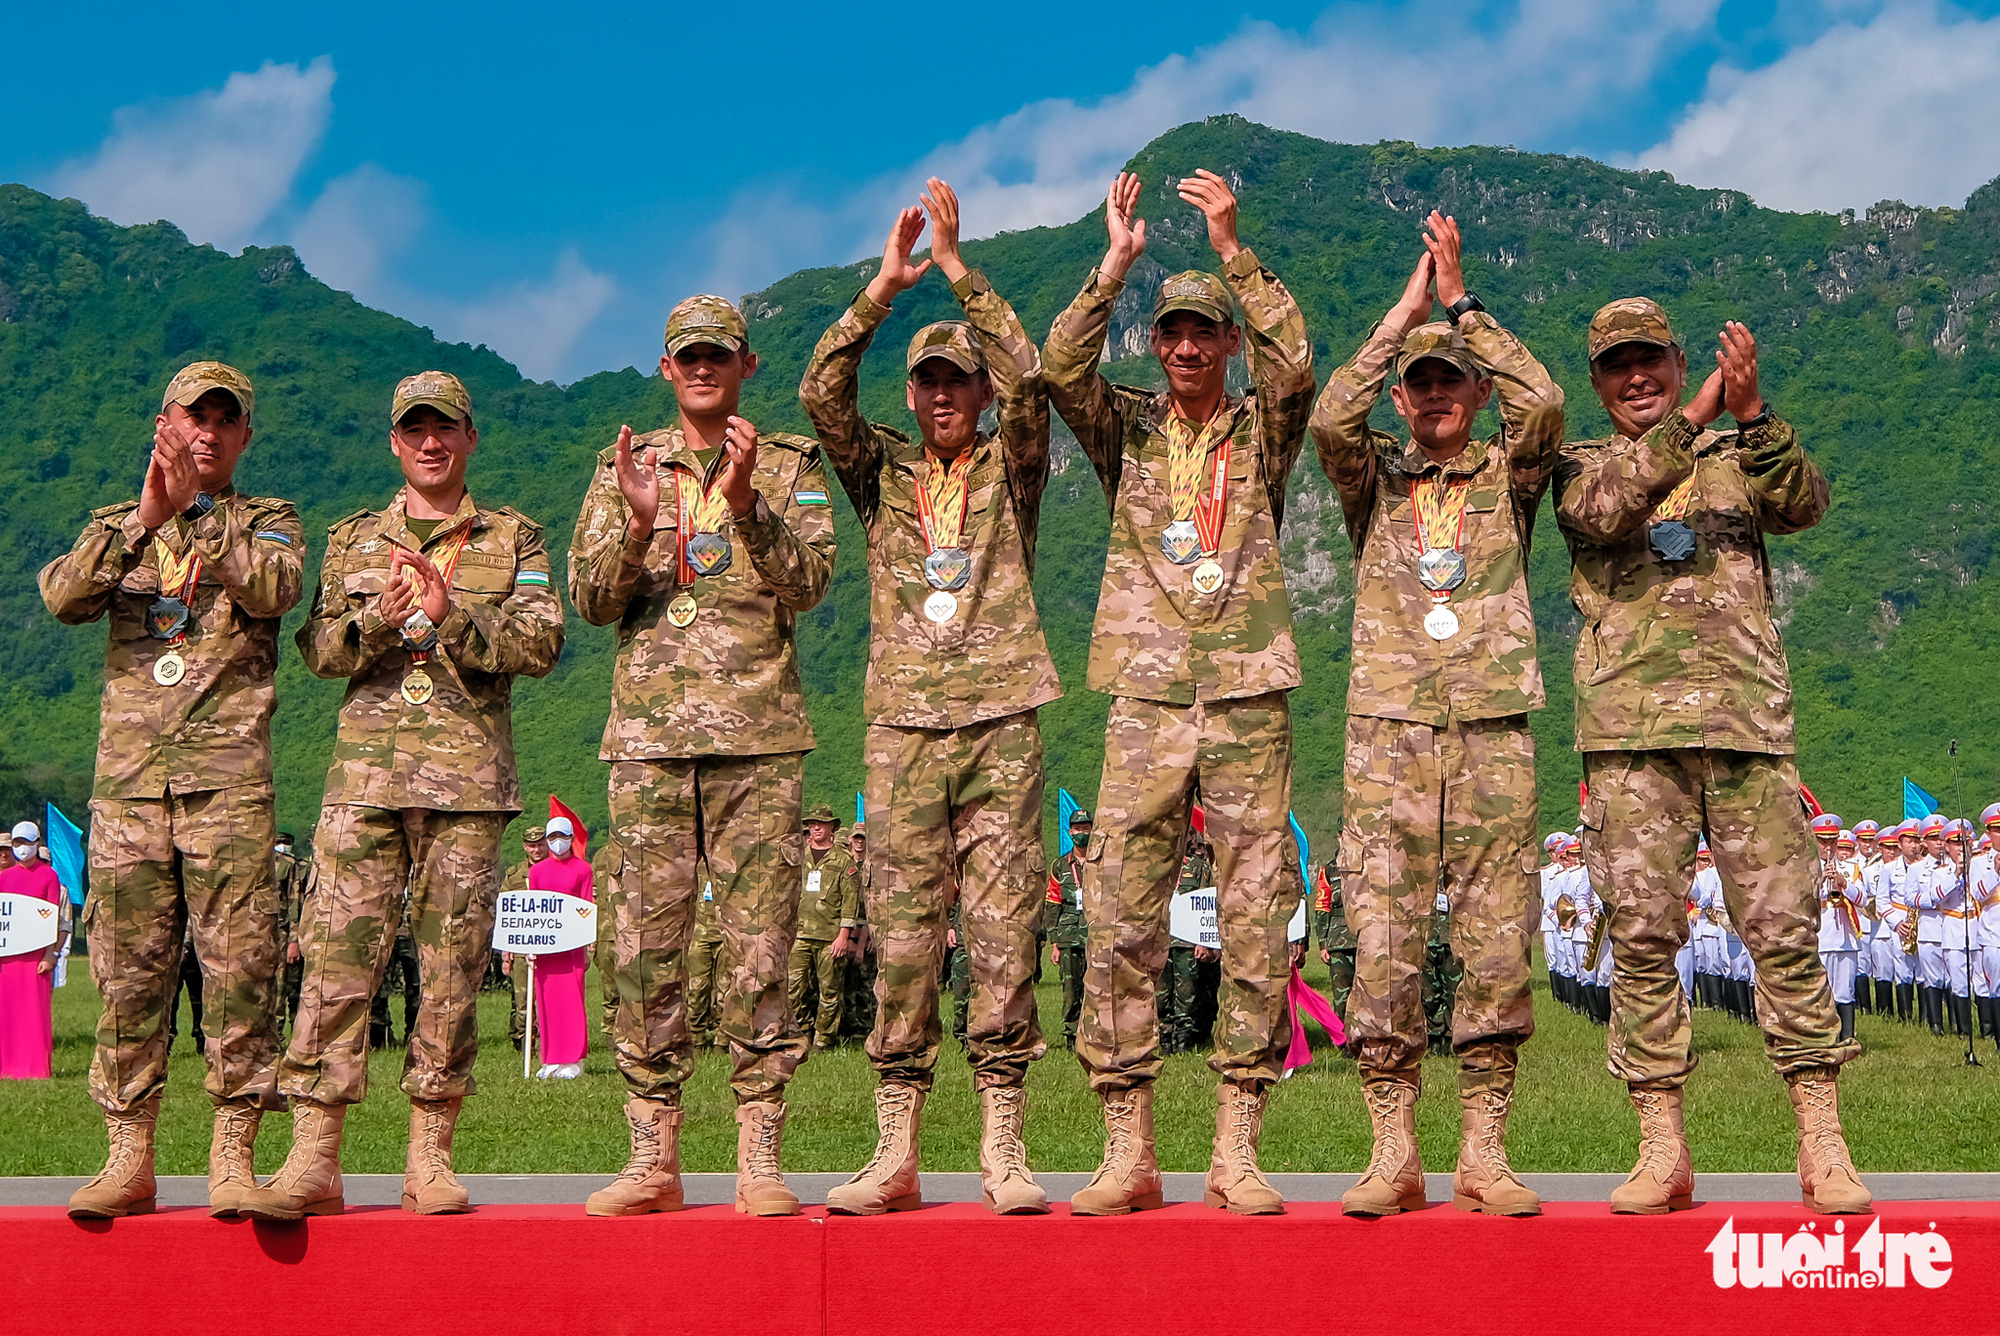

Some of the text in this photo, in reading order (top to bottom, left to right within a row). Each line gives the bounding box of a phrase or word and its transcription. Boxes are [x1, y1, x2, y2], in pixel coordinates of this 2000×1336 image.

[501, 894, 564, 914] BÊ-LA-RÚT
[501, 917, 563, 929] БЕЛАРУСЬ
[508, 934, 556, 946] BELARUS
